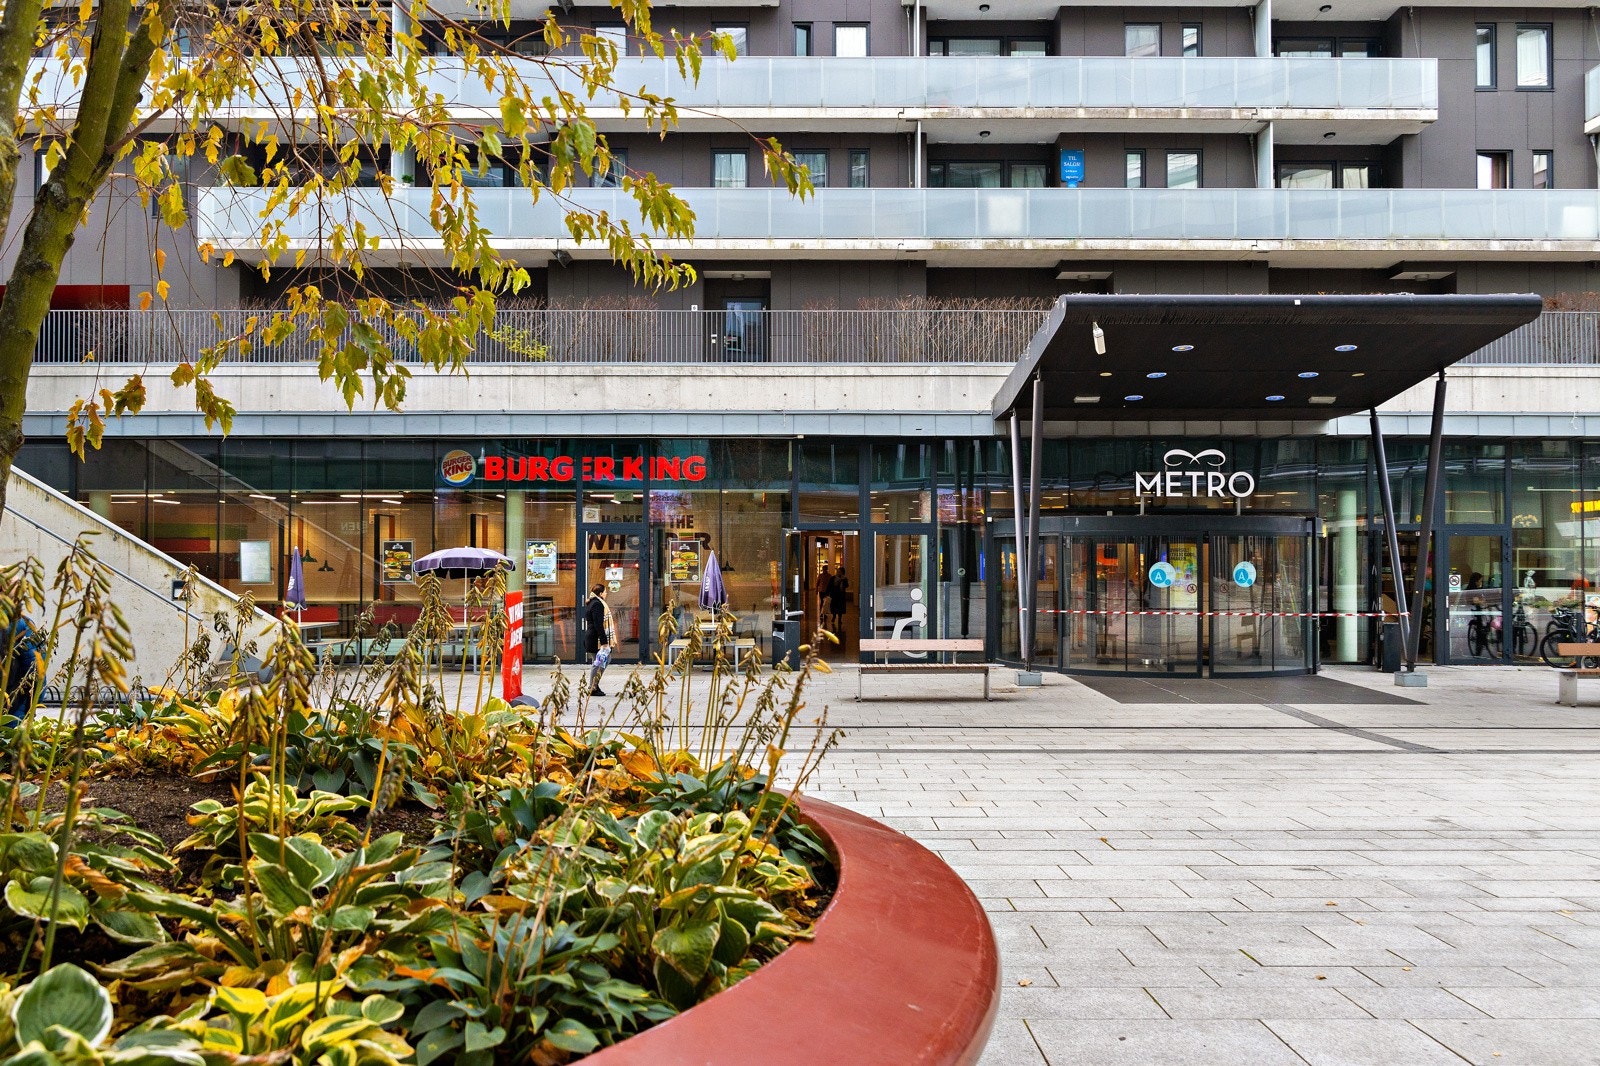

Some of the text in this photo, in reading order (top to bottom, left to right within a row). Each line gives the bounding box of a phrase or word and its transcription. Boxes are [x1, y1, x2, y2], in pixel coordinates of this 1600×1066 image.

[442, 455, 472, 470] BURGER
[443, 461, 473, 479] KING
[484, 455, 707, 481] BURGER KING
[1135, 470, 1255, 498] METRO
[669, 514, 694, 529] THE
[1154, 571, 1163, 581] A
[1239, 571, 1245, 581] A
